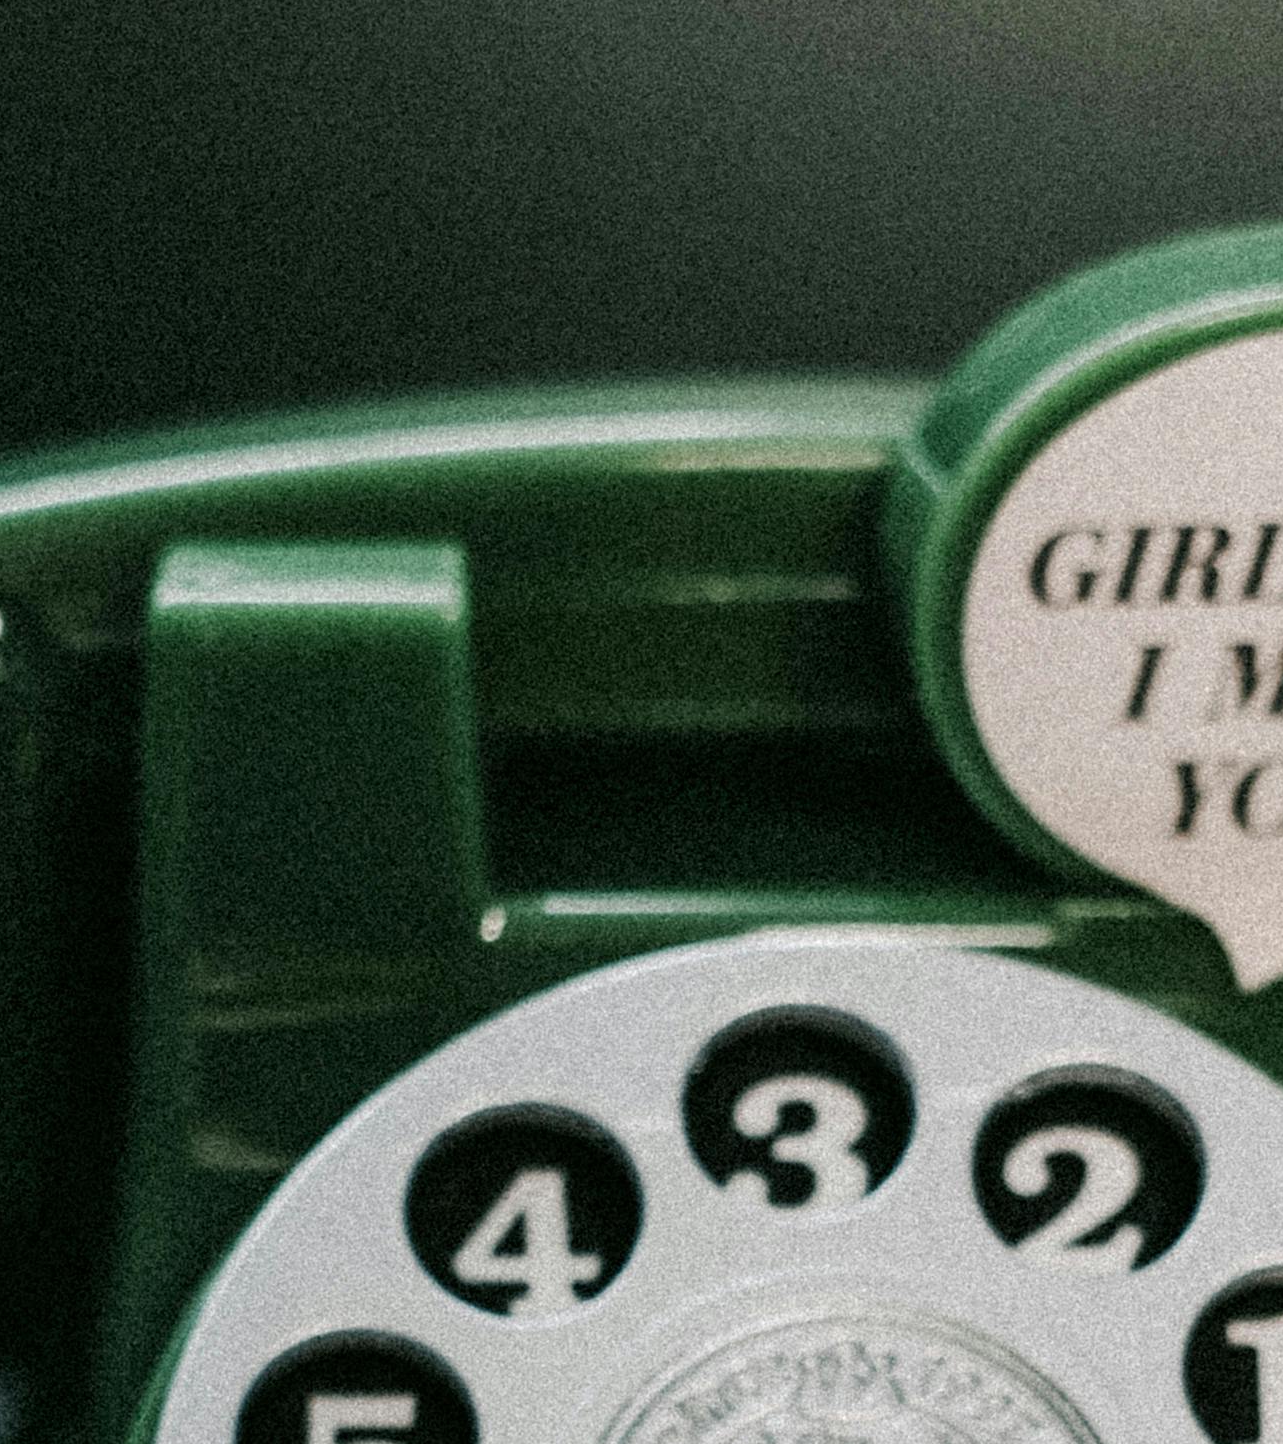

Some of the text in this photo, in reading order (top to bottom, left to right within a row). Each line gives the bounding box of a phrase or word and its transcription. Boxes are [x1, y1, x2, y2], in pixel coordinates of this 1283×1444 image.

[1111, 641, 1169, 726] I
[715, 1074, 870, 1209] 3
[1002, 1126, 1144, 1274] 2
[452, 1169, 601, 1316] 4
